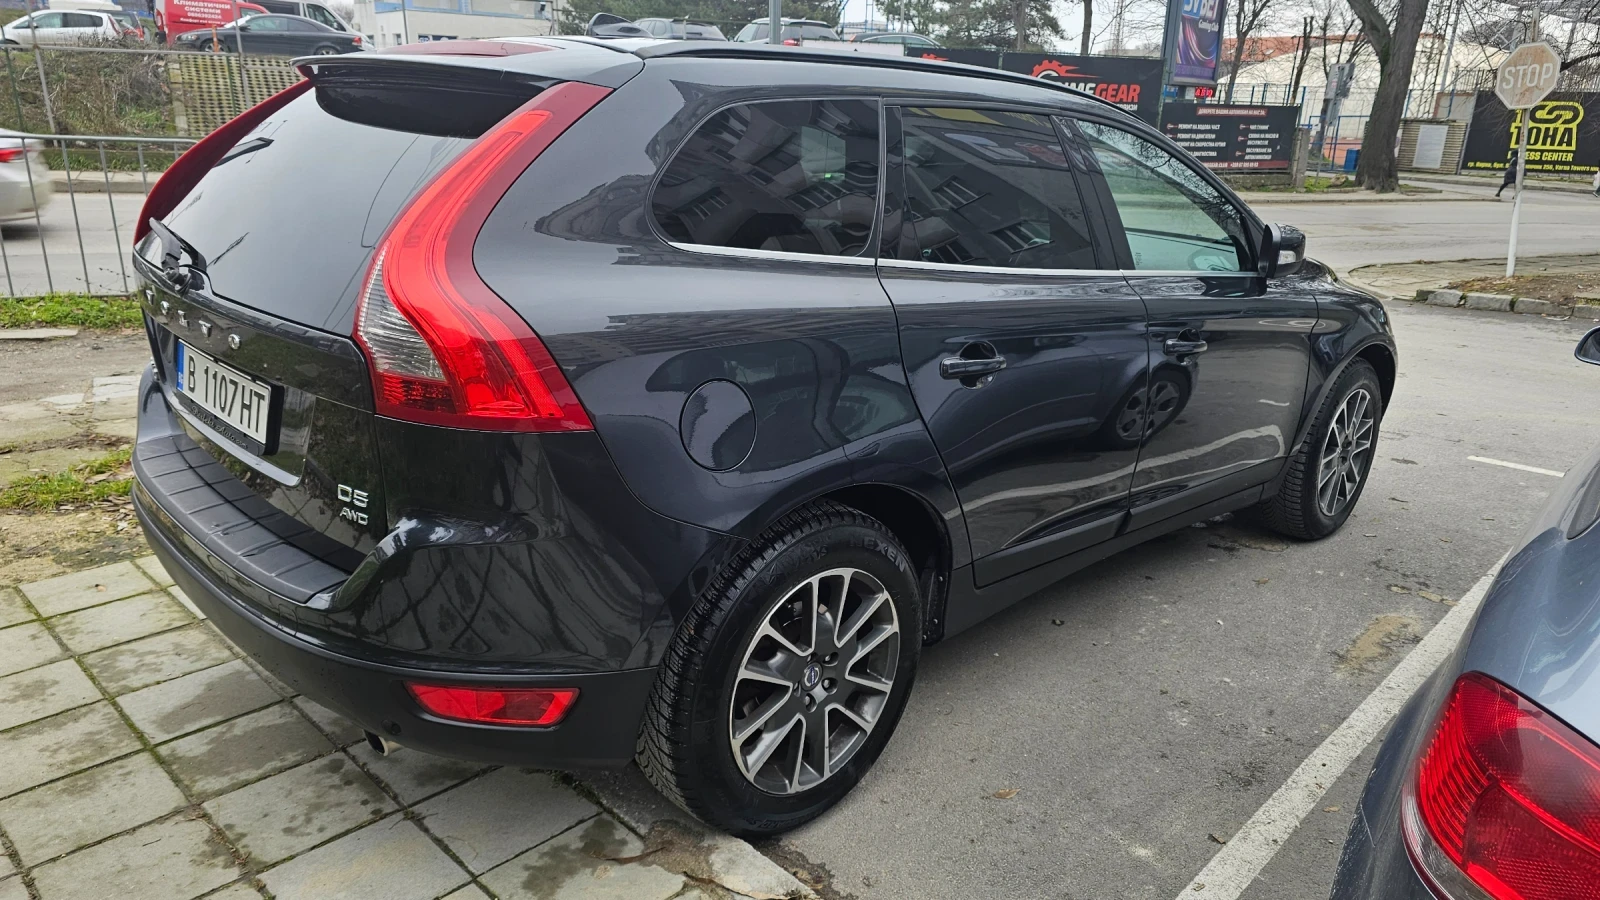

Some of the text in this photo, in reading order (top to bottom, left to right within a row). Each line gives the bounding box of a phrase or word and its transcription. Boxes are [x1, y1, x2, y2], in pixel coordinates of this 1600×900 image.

[173, 0, 231, 9] Климатични
[184, 6, 221, 14] системи
[1502, 62, 1554, 89] STOP
[1541, 151, 1574, 162] CENTER
[145, 289, 241, 350] VOLVO
[204, 365, 240, 418] 1107
[338, 484, 369, 507] D5
[340, 507, 369, 525] AWD
[850, 536, 907, 573] NEXEN
